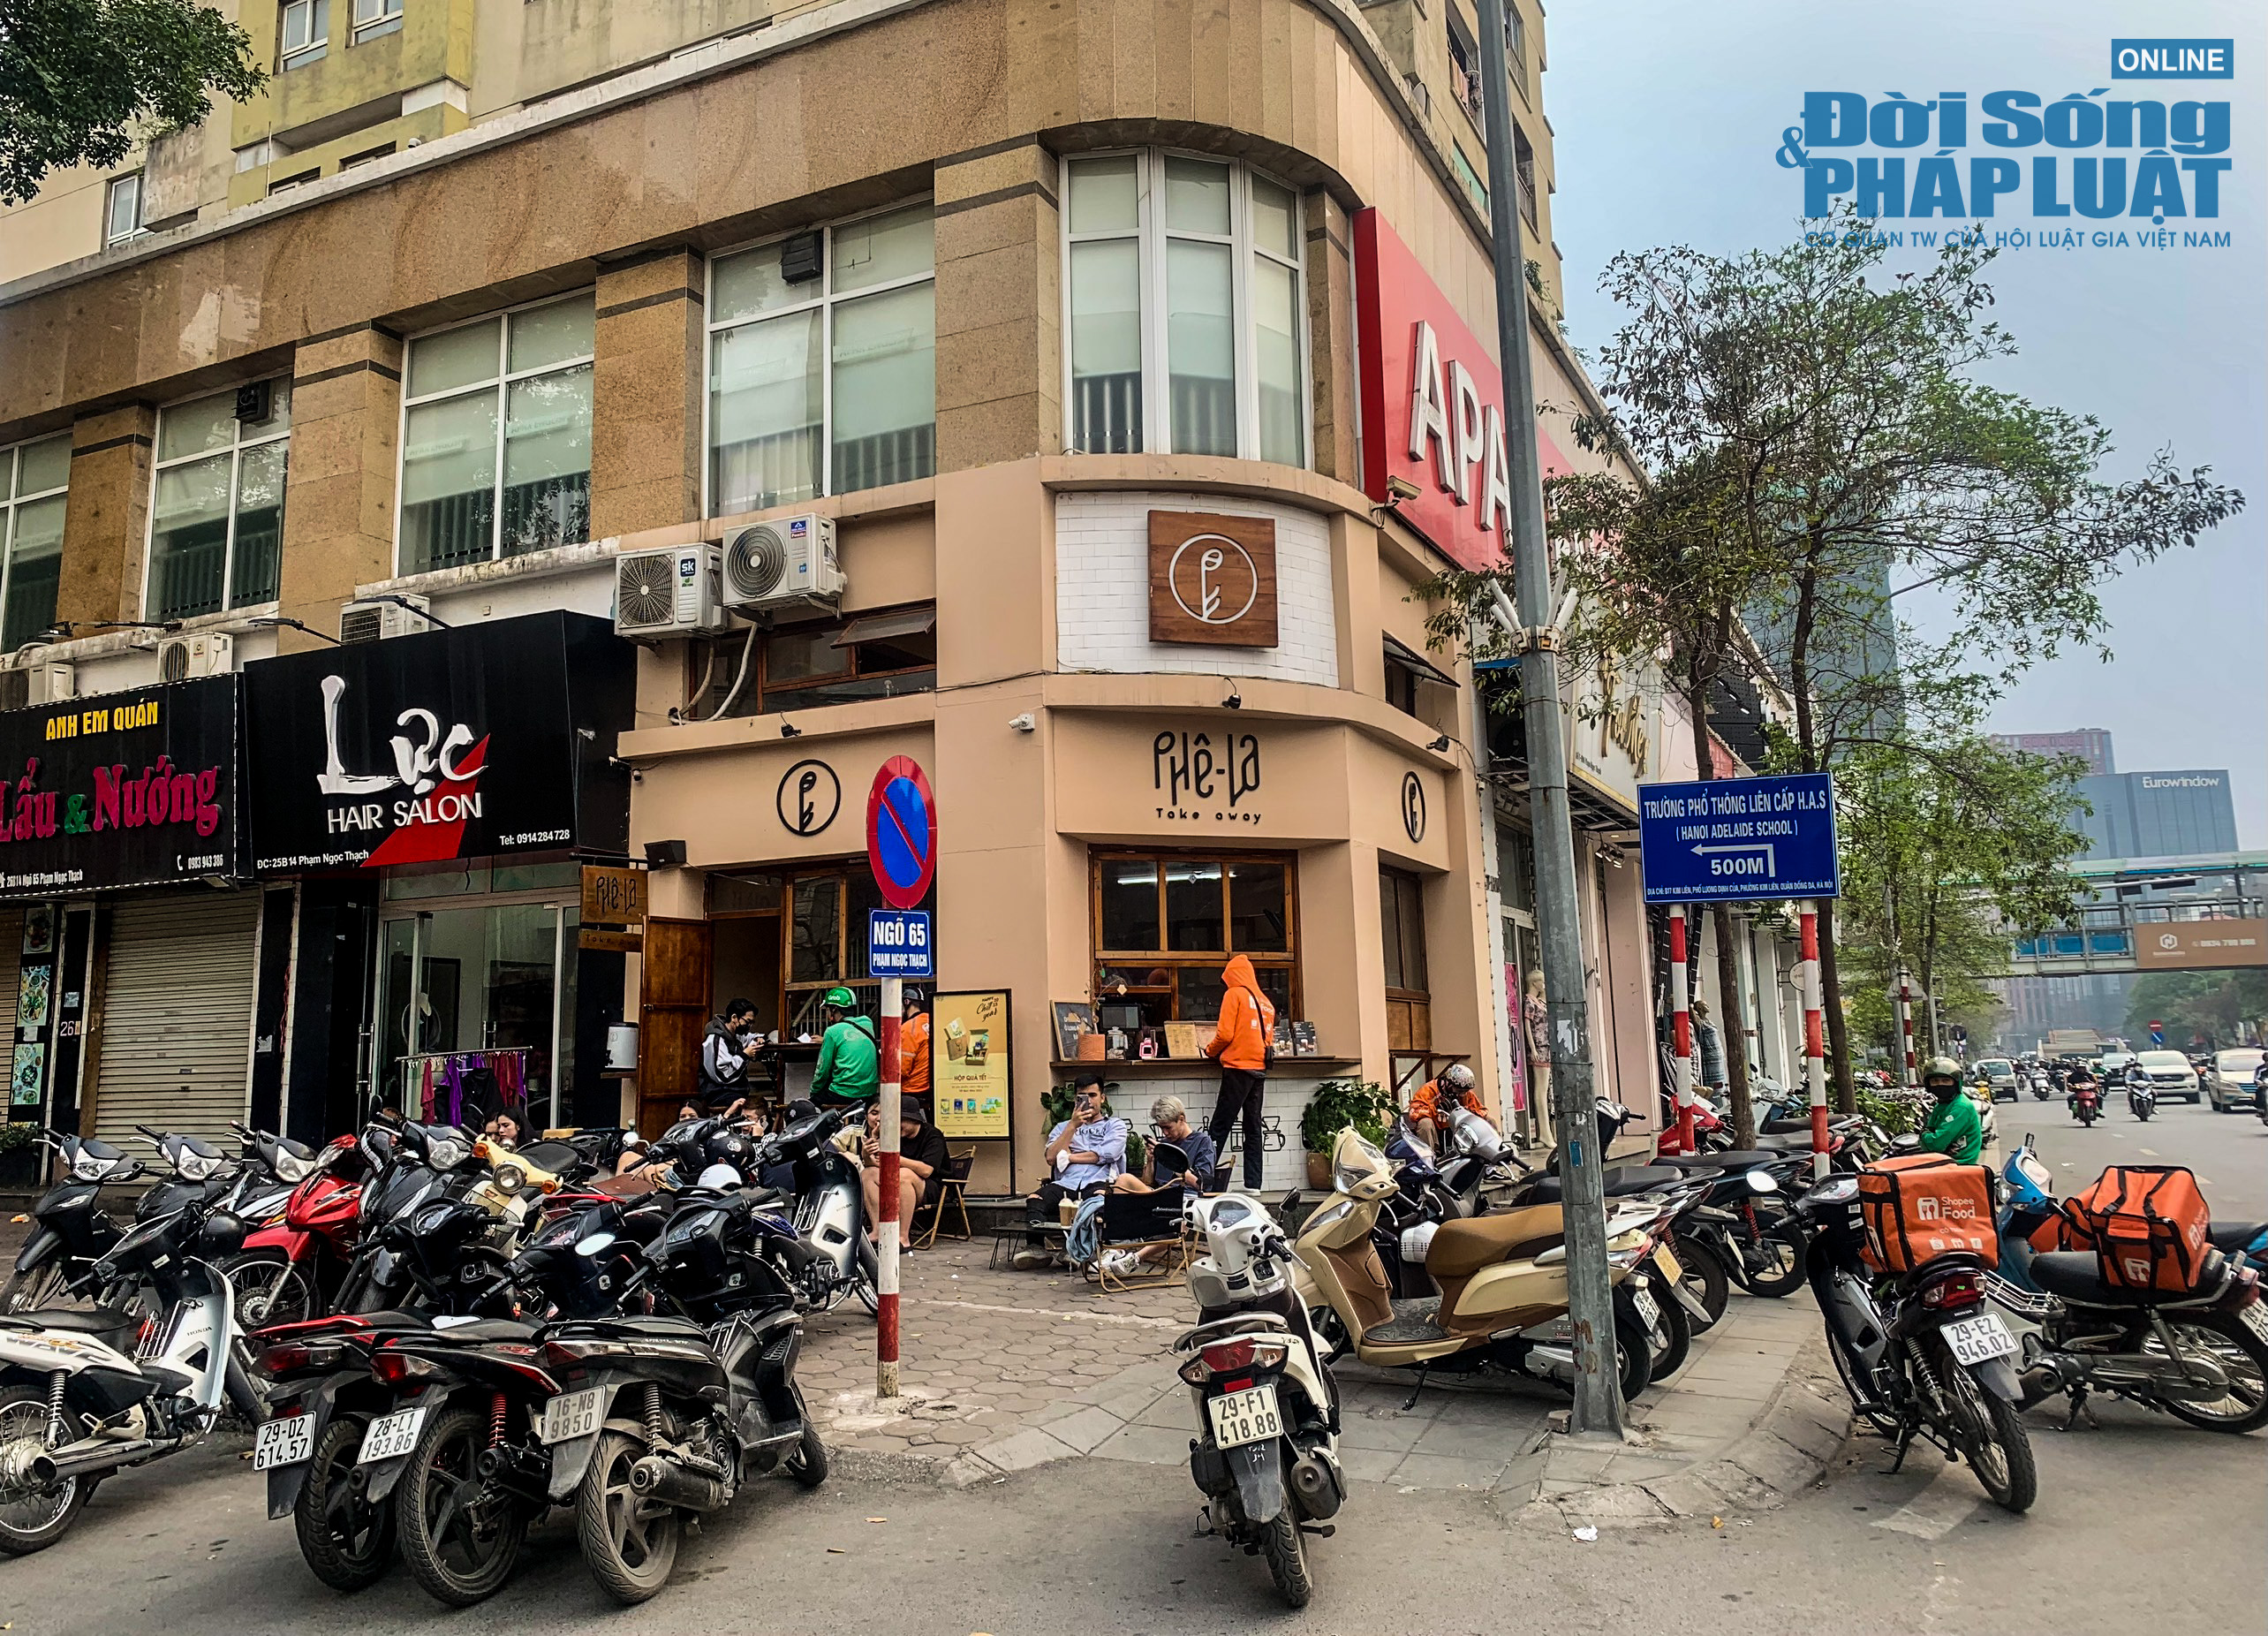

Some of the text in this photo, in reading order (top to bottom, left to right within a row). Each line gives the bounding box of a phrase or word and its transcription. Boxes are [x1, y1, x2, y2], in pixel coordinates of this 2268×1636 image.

[46, 697, 159, 740] ANH EM QUÁN
[64, 794, 87, 835] &
[93, 755, 219, 837] Nướng
[2143, 776, 2220, 789] Eurowindow
[327, 792, 482, 833] HAIR SALON
[1644, 786, 1826, 820] TRƯỜNG PHỔ THÔNG LIÊN CẤP H.A.S
[499, 833, 514, 845] Tel:
[1712, 822, 1754, 839] ADELAIDE
[299, 855, 321, 867] Phạm
[322, 852, 344, 865] Ngọc
[344, 849, 369, 862] Thạch
[1711, 857, 1765, 875] 500M
[873, 917, 926, 946] NGÕ 65
[873, 952, 927, 970] PHẠM NGỌC THẠCH
[1941, 1196, 1975, 1208] Shopee
[1941, 1206, 1977, 1219] Food
[186, 1326, 213, 1337] HONDA
[1951, 1317, 1998, 1343] 29-E2
[1956, 1333, 2014, 1361] 946.02
[556, 1391, 595, 1418] 16-N8
[1219, 1390, 1266, 1420] 29-F1
[263, 1417, 306, 1445] 29-D2
[374, 1413, 416, 1439] 28-L1
[550, 1412, 593, 1440] 9850
[1220, 1412, 1278, 1444] 418.88
[257, 1438, 308, 1468] 614.57
[365, 1432, 414, 1459] 193.86
